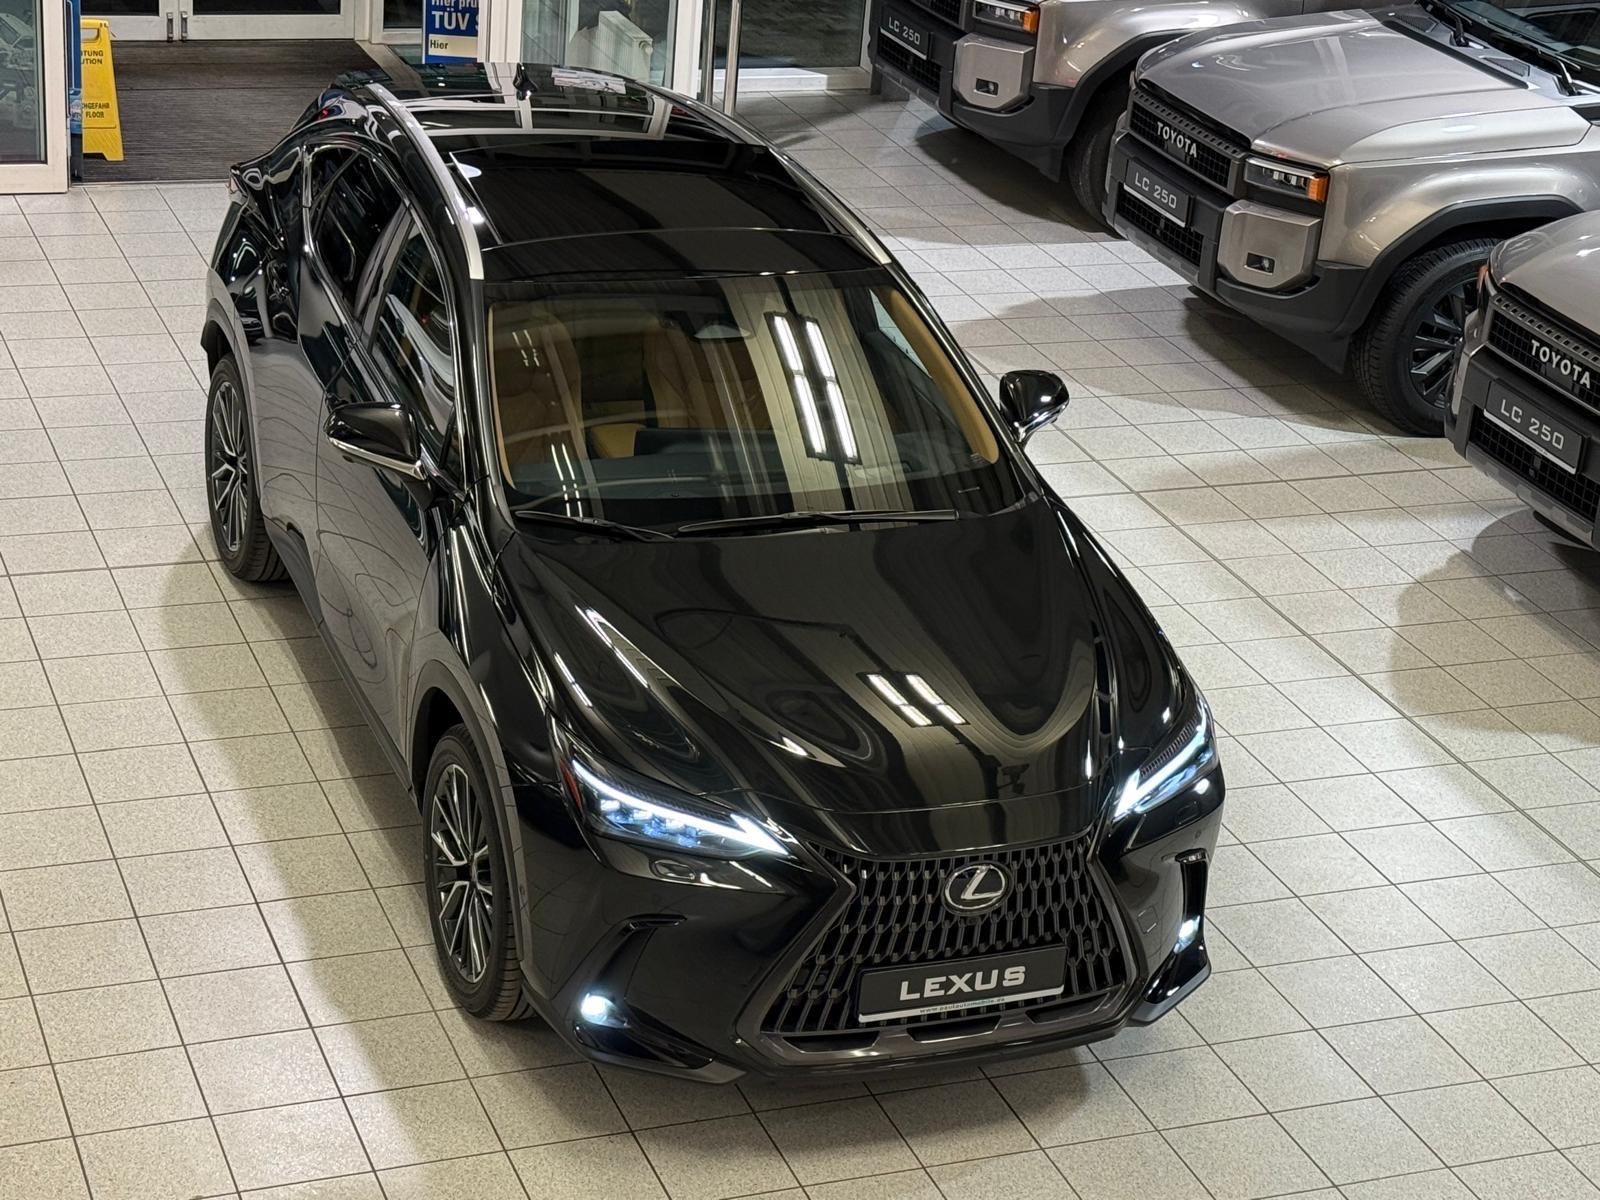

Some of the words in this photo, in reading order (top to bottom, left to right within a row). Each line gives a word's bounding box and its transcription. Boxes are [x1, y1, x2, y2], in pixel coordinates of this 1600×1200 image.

[431, 8, 470, 30] TÜV
[888, 16, 900, 33] LC
[902, 26, 921, 46] 250
[430, 39, 449, 50] Hier
[1156, 121, 1198, 158] TOYOTA
[1134, 171, 1150, 191] LC
[1153, 184, 1177, 209] 250
[1530, 338, 1591, 389] TOYOTA
[1500, 399, 1523, 424] LC
[1528, 417, 1565, 450] 250
[899, 965, 1026, 1001] LEXUS
